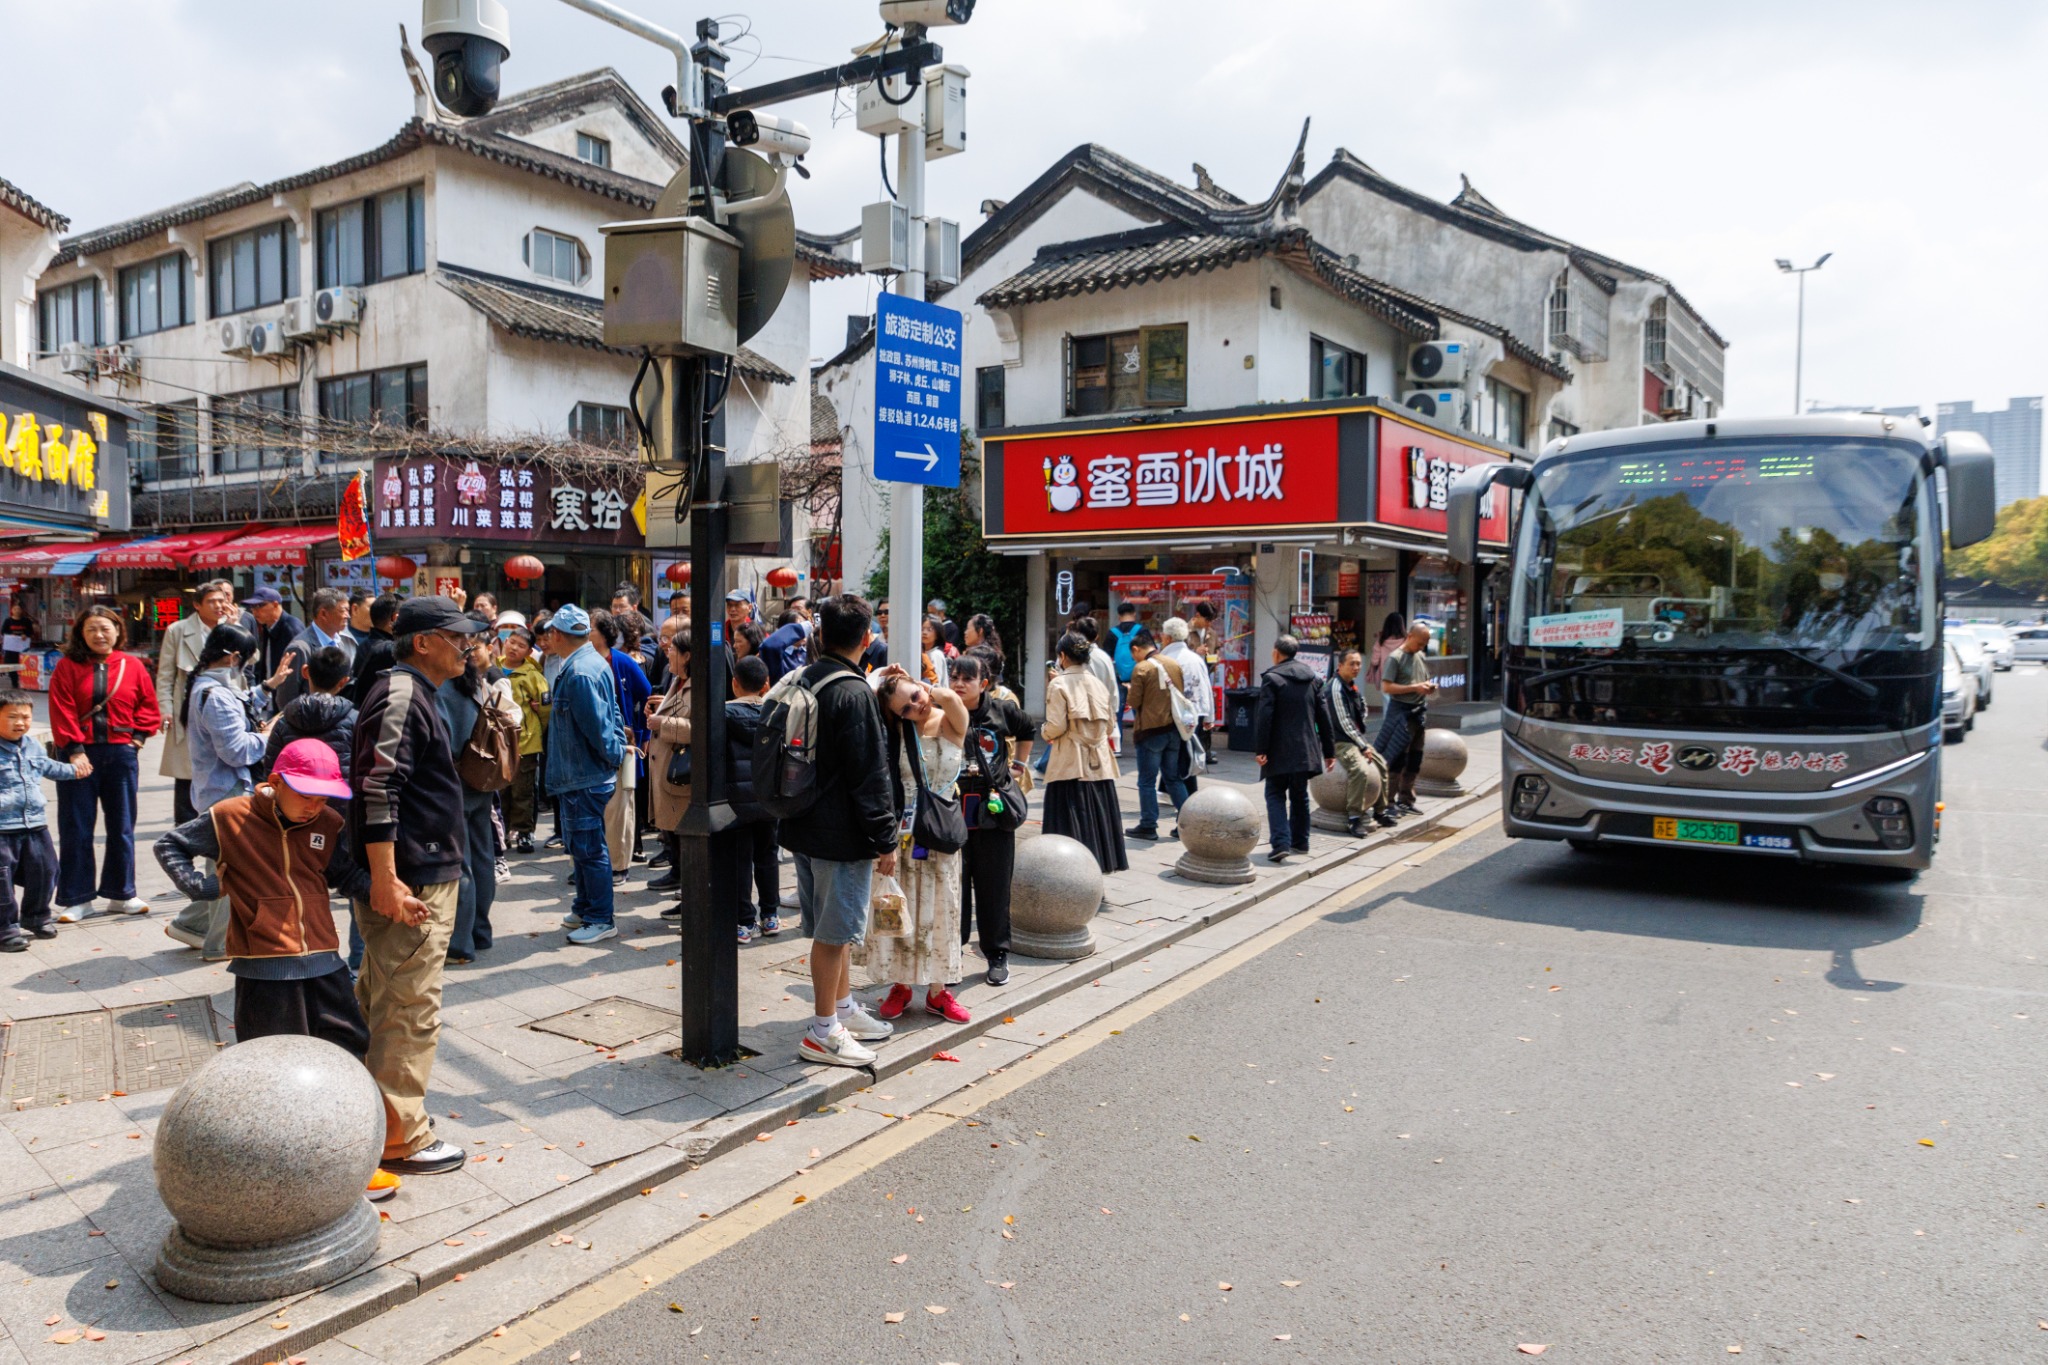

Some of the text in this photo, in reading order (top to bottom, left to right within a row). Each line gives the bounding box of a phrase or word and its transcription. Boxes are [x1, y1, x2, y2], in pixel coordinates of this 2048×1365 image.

[885, 312, 956, 350] 旅游定制公交
[1087, 443, 1283, 508] 蜜雪冰城
